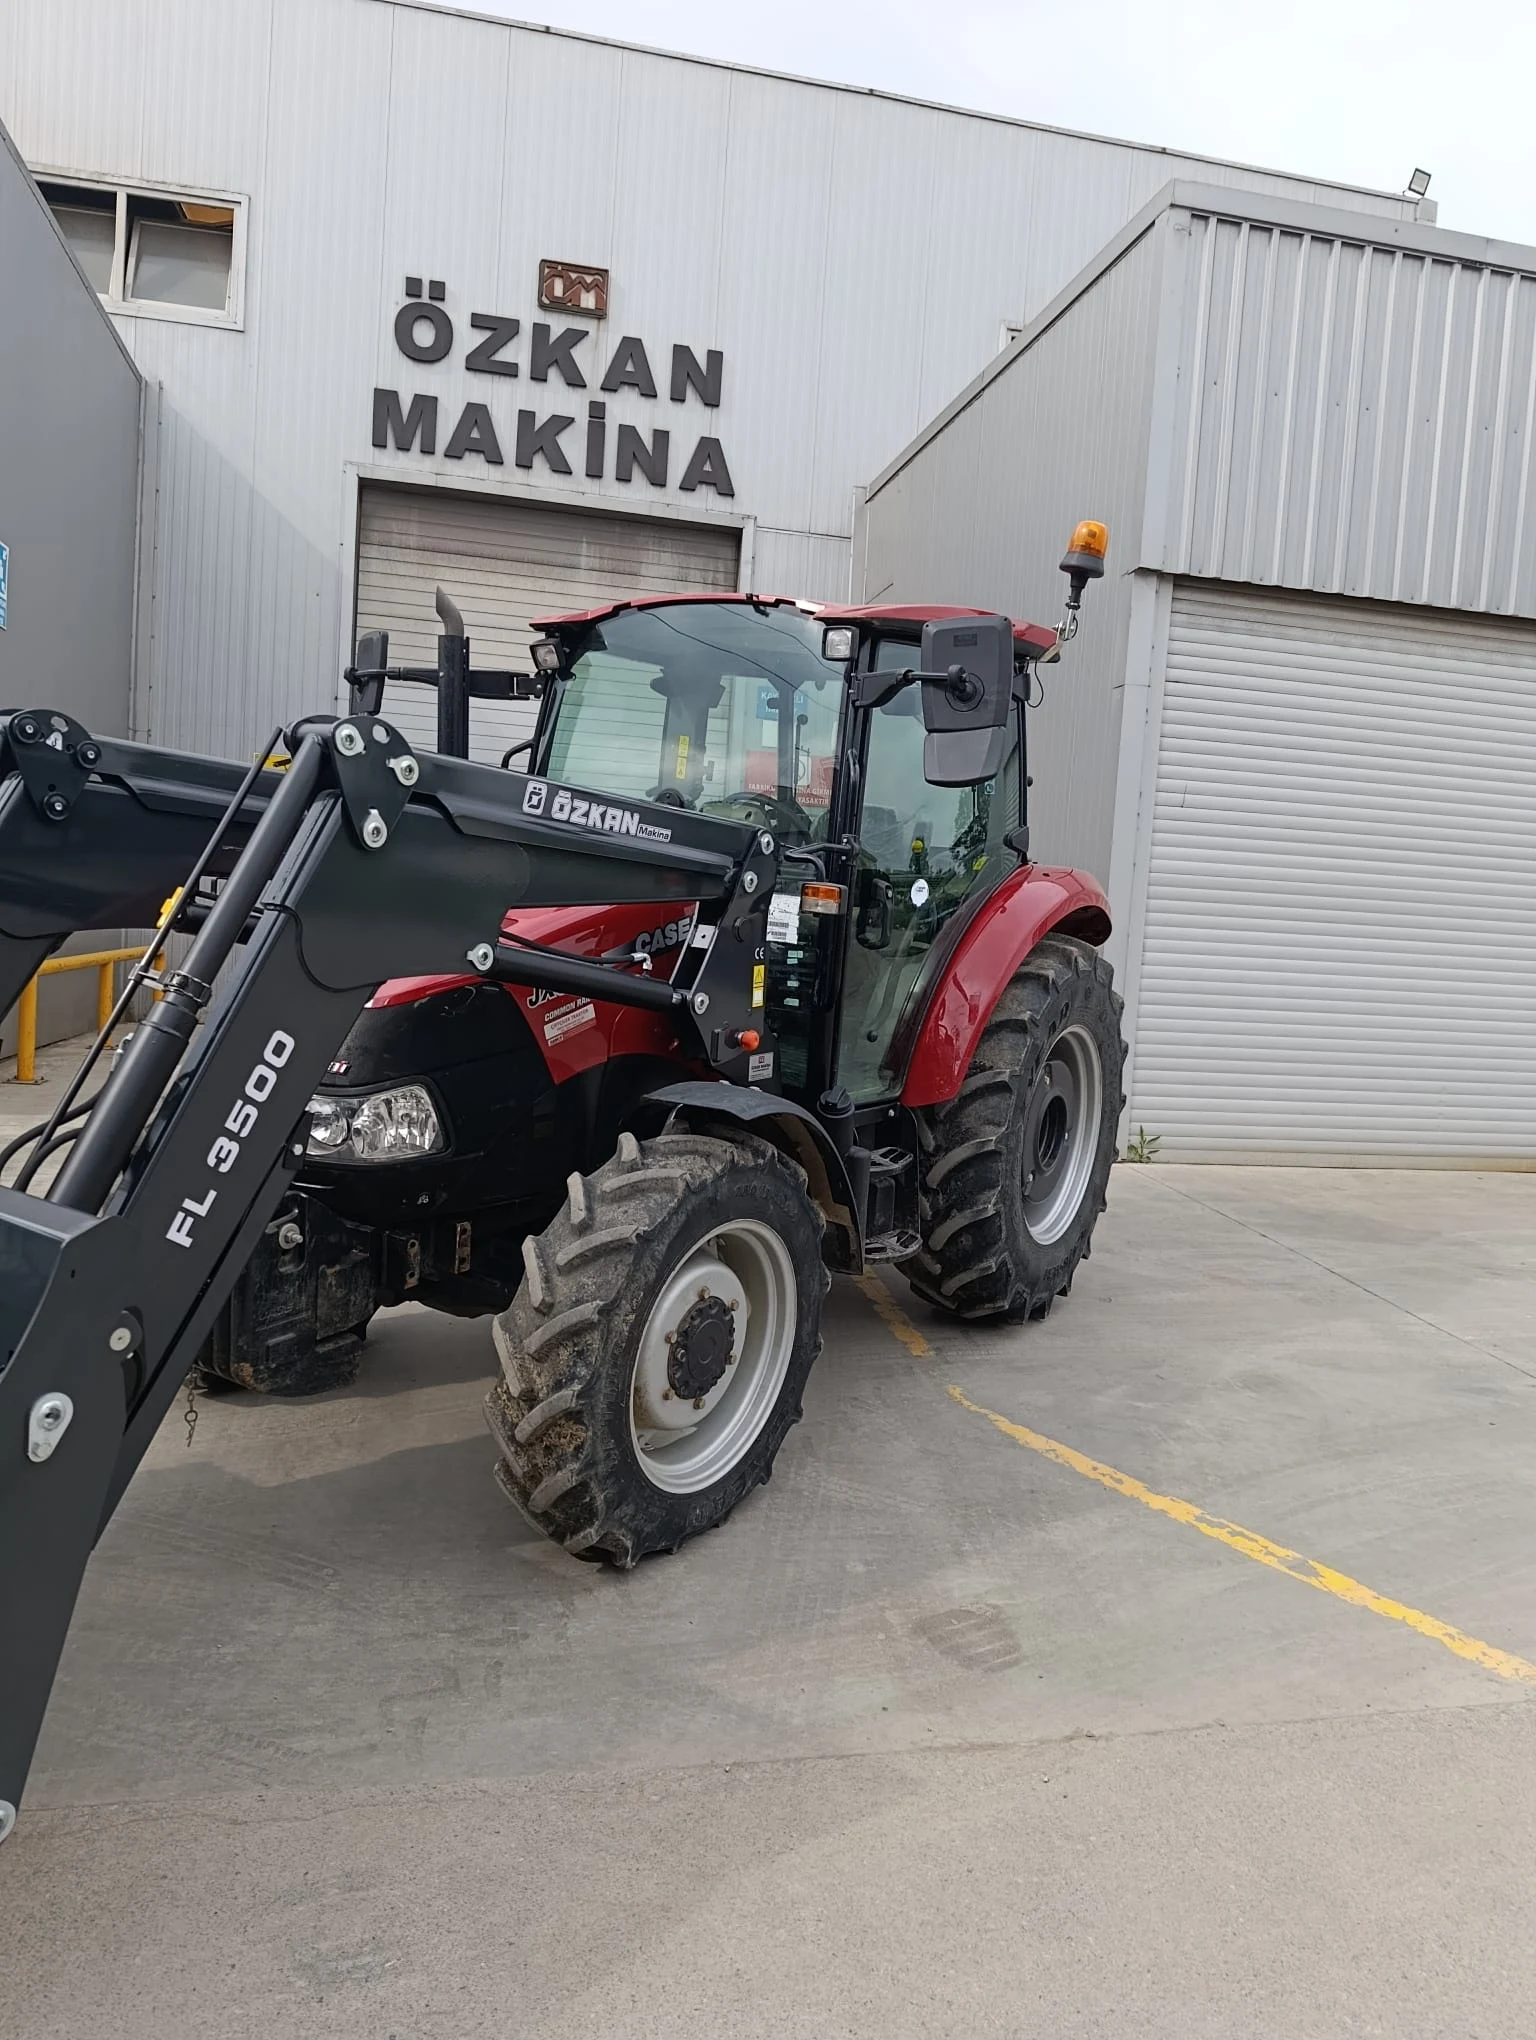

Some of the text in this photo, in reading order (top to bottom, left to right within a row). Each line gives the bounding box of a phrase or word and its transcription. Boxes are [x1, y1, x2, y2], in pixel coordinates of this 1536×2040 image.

[394, 275, 724, 408] ÖZKAN
[371, 387, 735, 498] MAKİNA
[551, 790, 640, 836] ÖZKAN
[638, 825, 671, 841] Makina
[635, 917, 691, 953] CASE
[544, 1002, 576, 1022] COMMON
[165, 1029, 295, 1249] FL 3500
